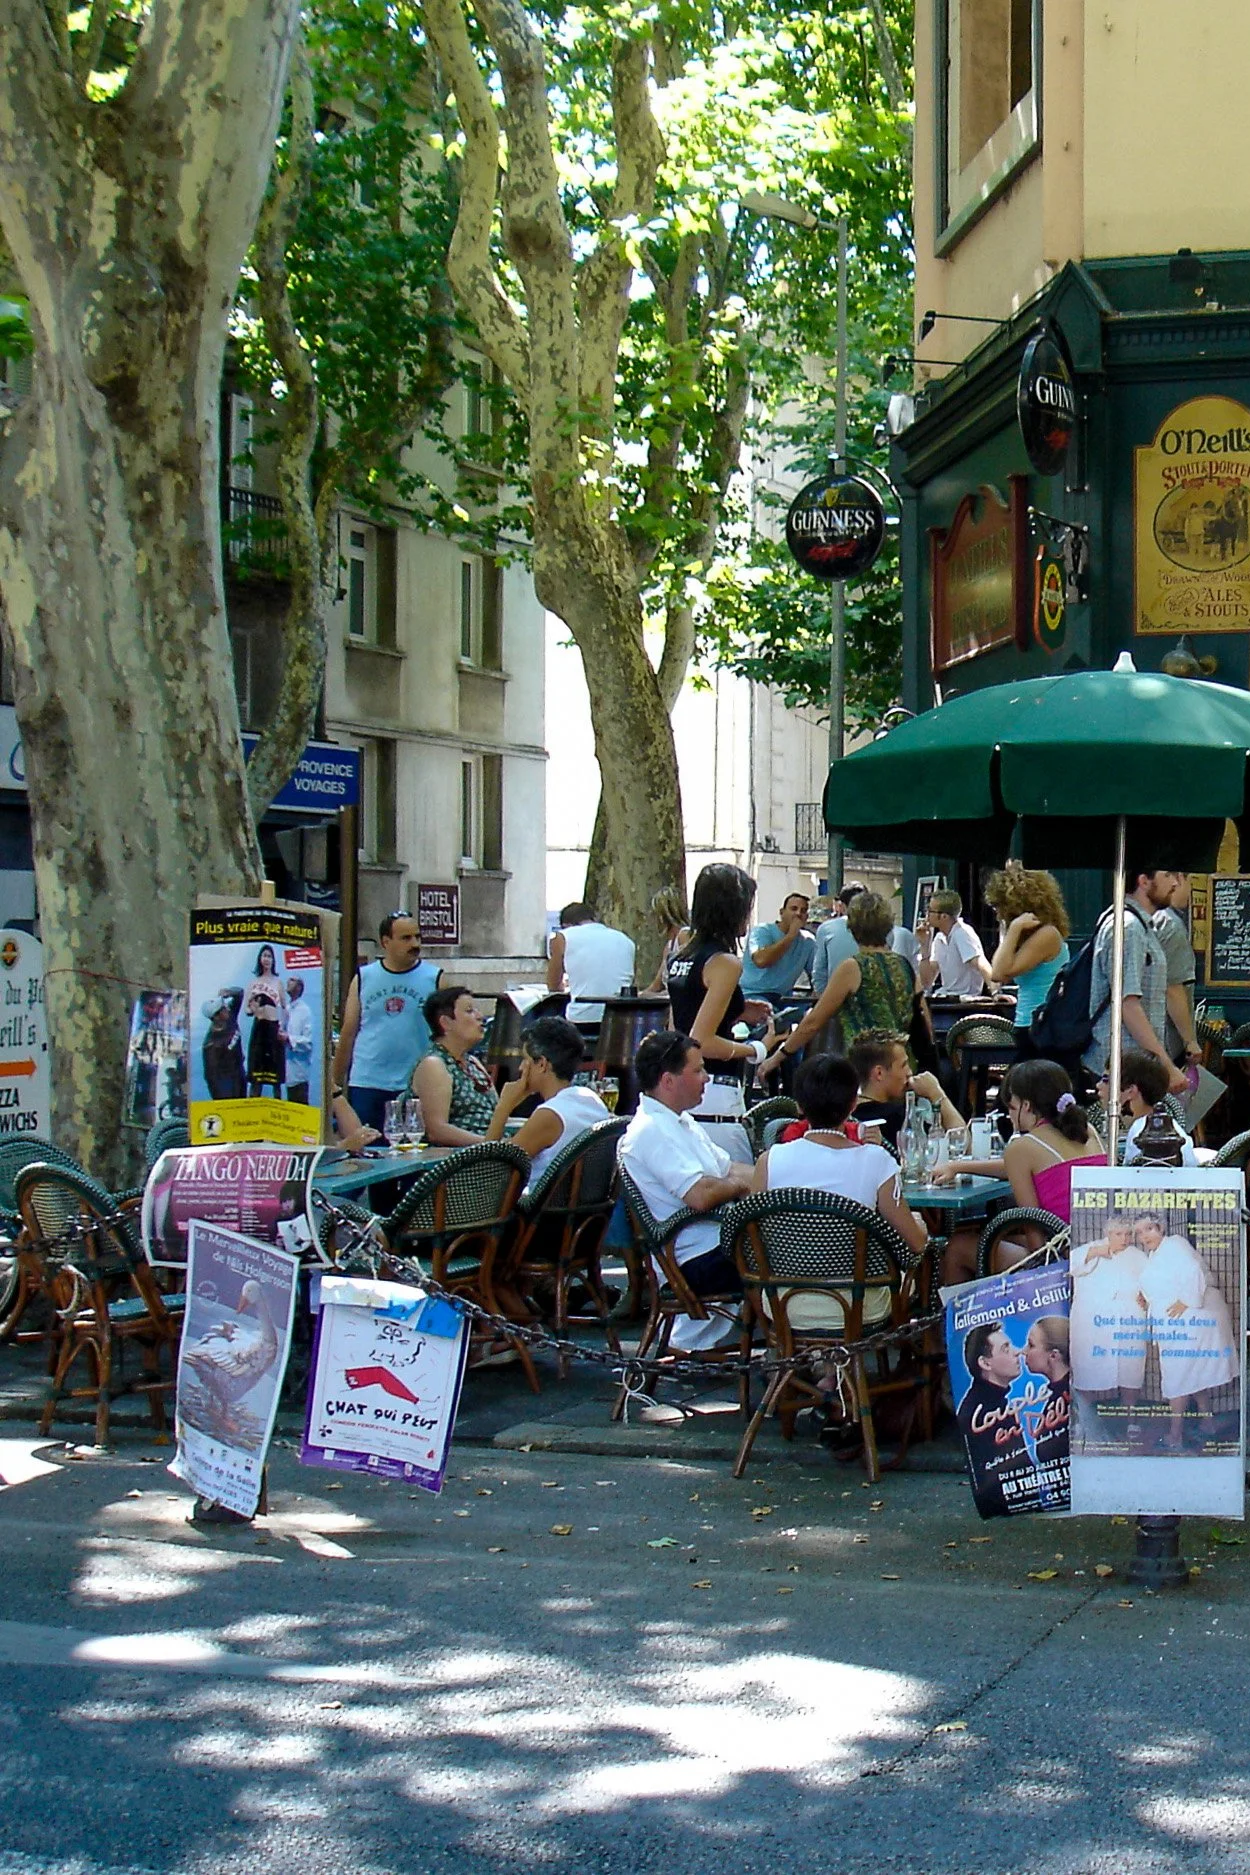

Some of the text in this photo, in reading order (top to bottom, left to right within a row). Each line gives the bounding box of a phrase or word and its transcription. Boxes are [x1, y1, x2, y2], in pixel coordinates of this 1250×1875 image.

[791, 508, 876, 532] GUINNESS
[294, 778, 346, 795] VOYAGES
[420, 891, 451, 907] HOTEL
[196, 920, 224, 935] Plus
[228, 918, 259, 933] vraie
[263, 921, 281, 936] que
[420, 910, 454, 926] BRISTOL
[173, 1153, 307, 1182] TANGO NERUDA
[1073, 1191, 1237, 1210] LES BAZARETTES
[1018, 1296, 1030, 1312] &
[326, 1400, 368, 1416] CHAT
[402, 1412, 438, 1431] PEUT
[971, 1381, 1054, 1434] Couple
[995, 1424, 1024, 1445] en
[1001, 1478, 1017, 1496] AU
